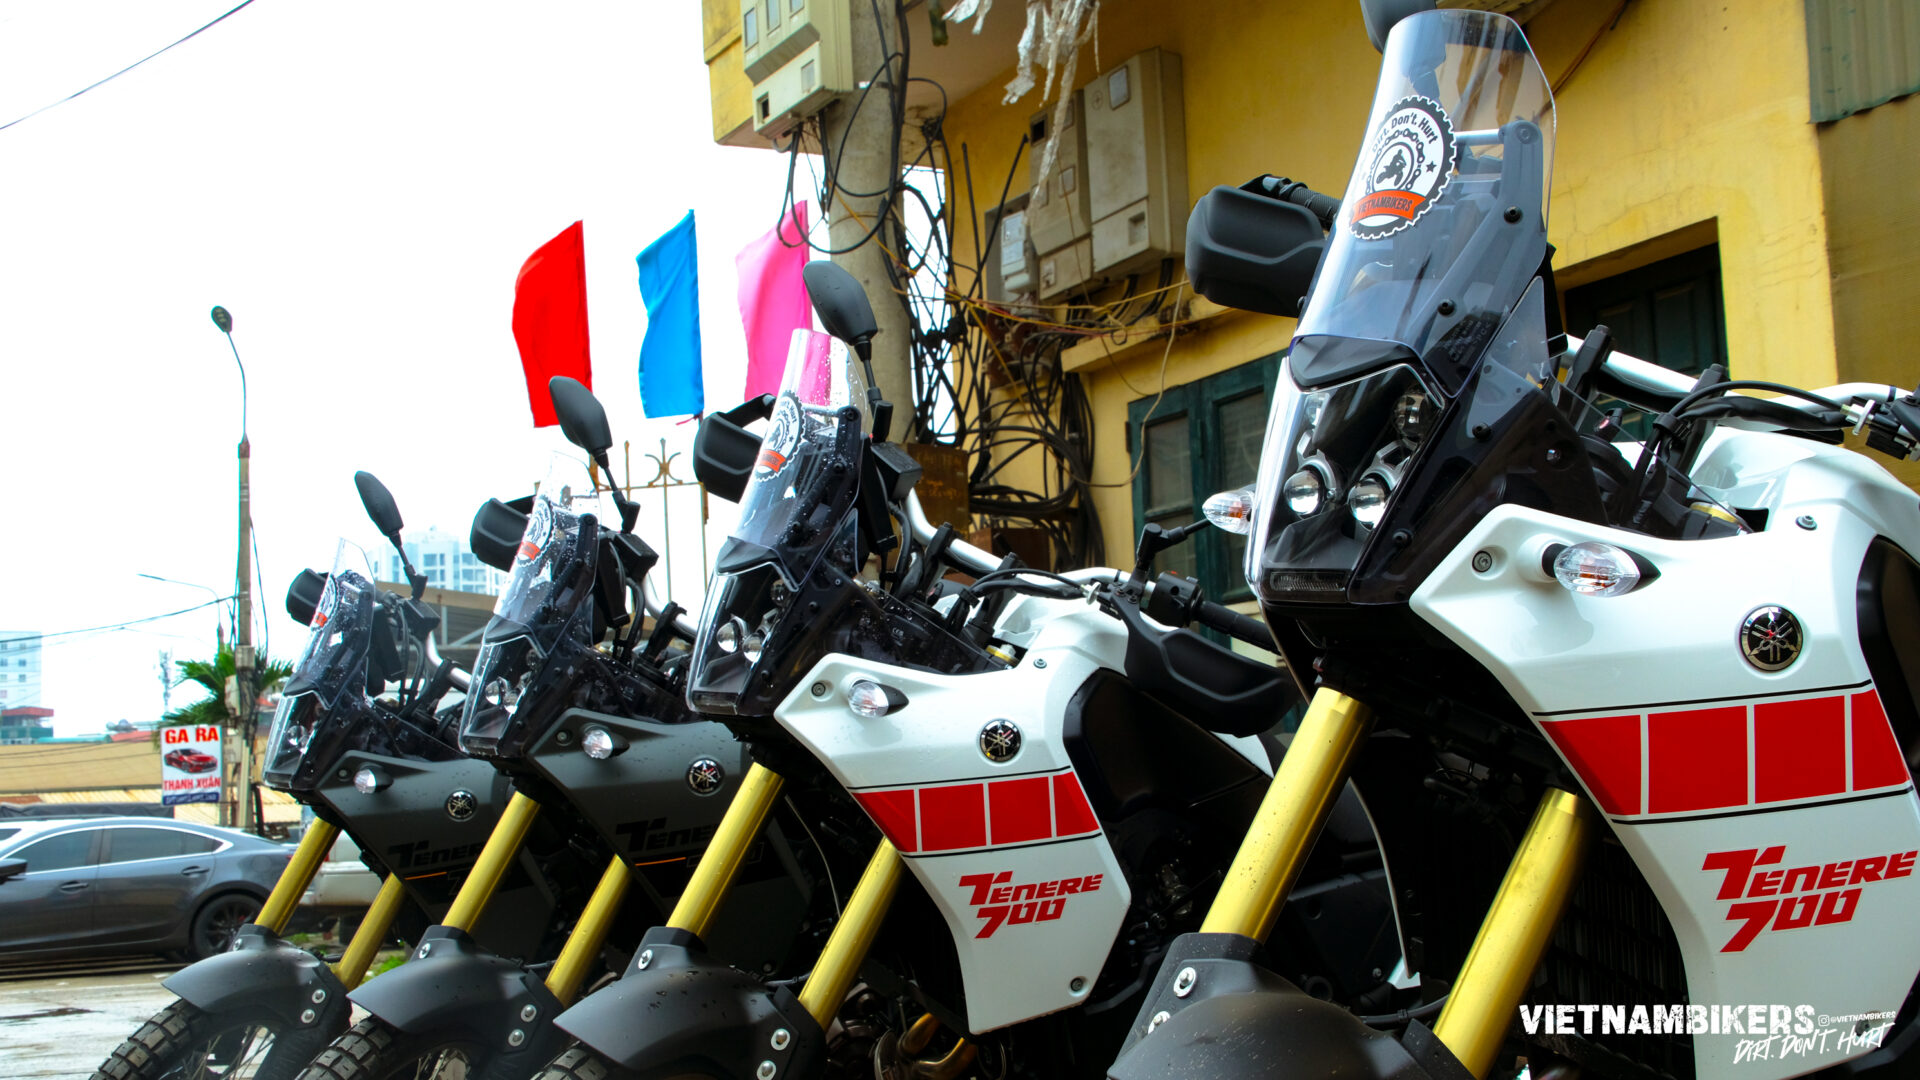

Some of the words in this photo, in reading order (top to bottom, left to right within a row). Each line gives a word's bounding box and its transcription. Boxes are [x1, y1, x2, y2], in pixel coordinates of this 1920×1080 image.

[1391, 112, 1417, 129] Don't.
[1417, 117, 1438, 144] Hurt
[165, 728, 189, 744] GA
[195, 727, 218, 742] RA
[164, 779, 194, 791] THANH
[975, 898, 1066, 939] 700
[1719, 888, 1862, 952] 700
